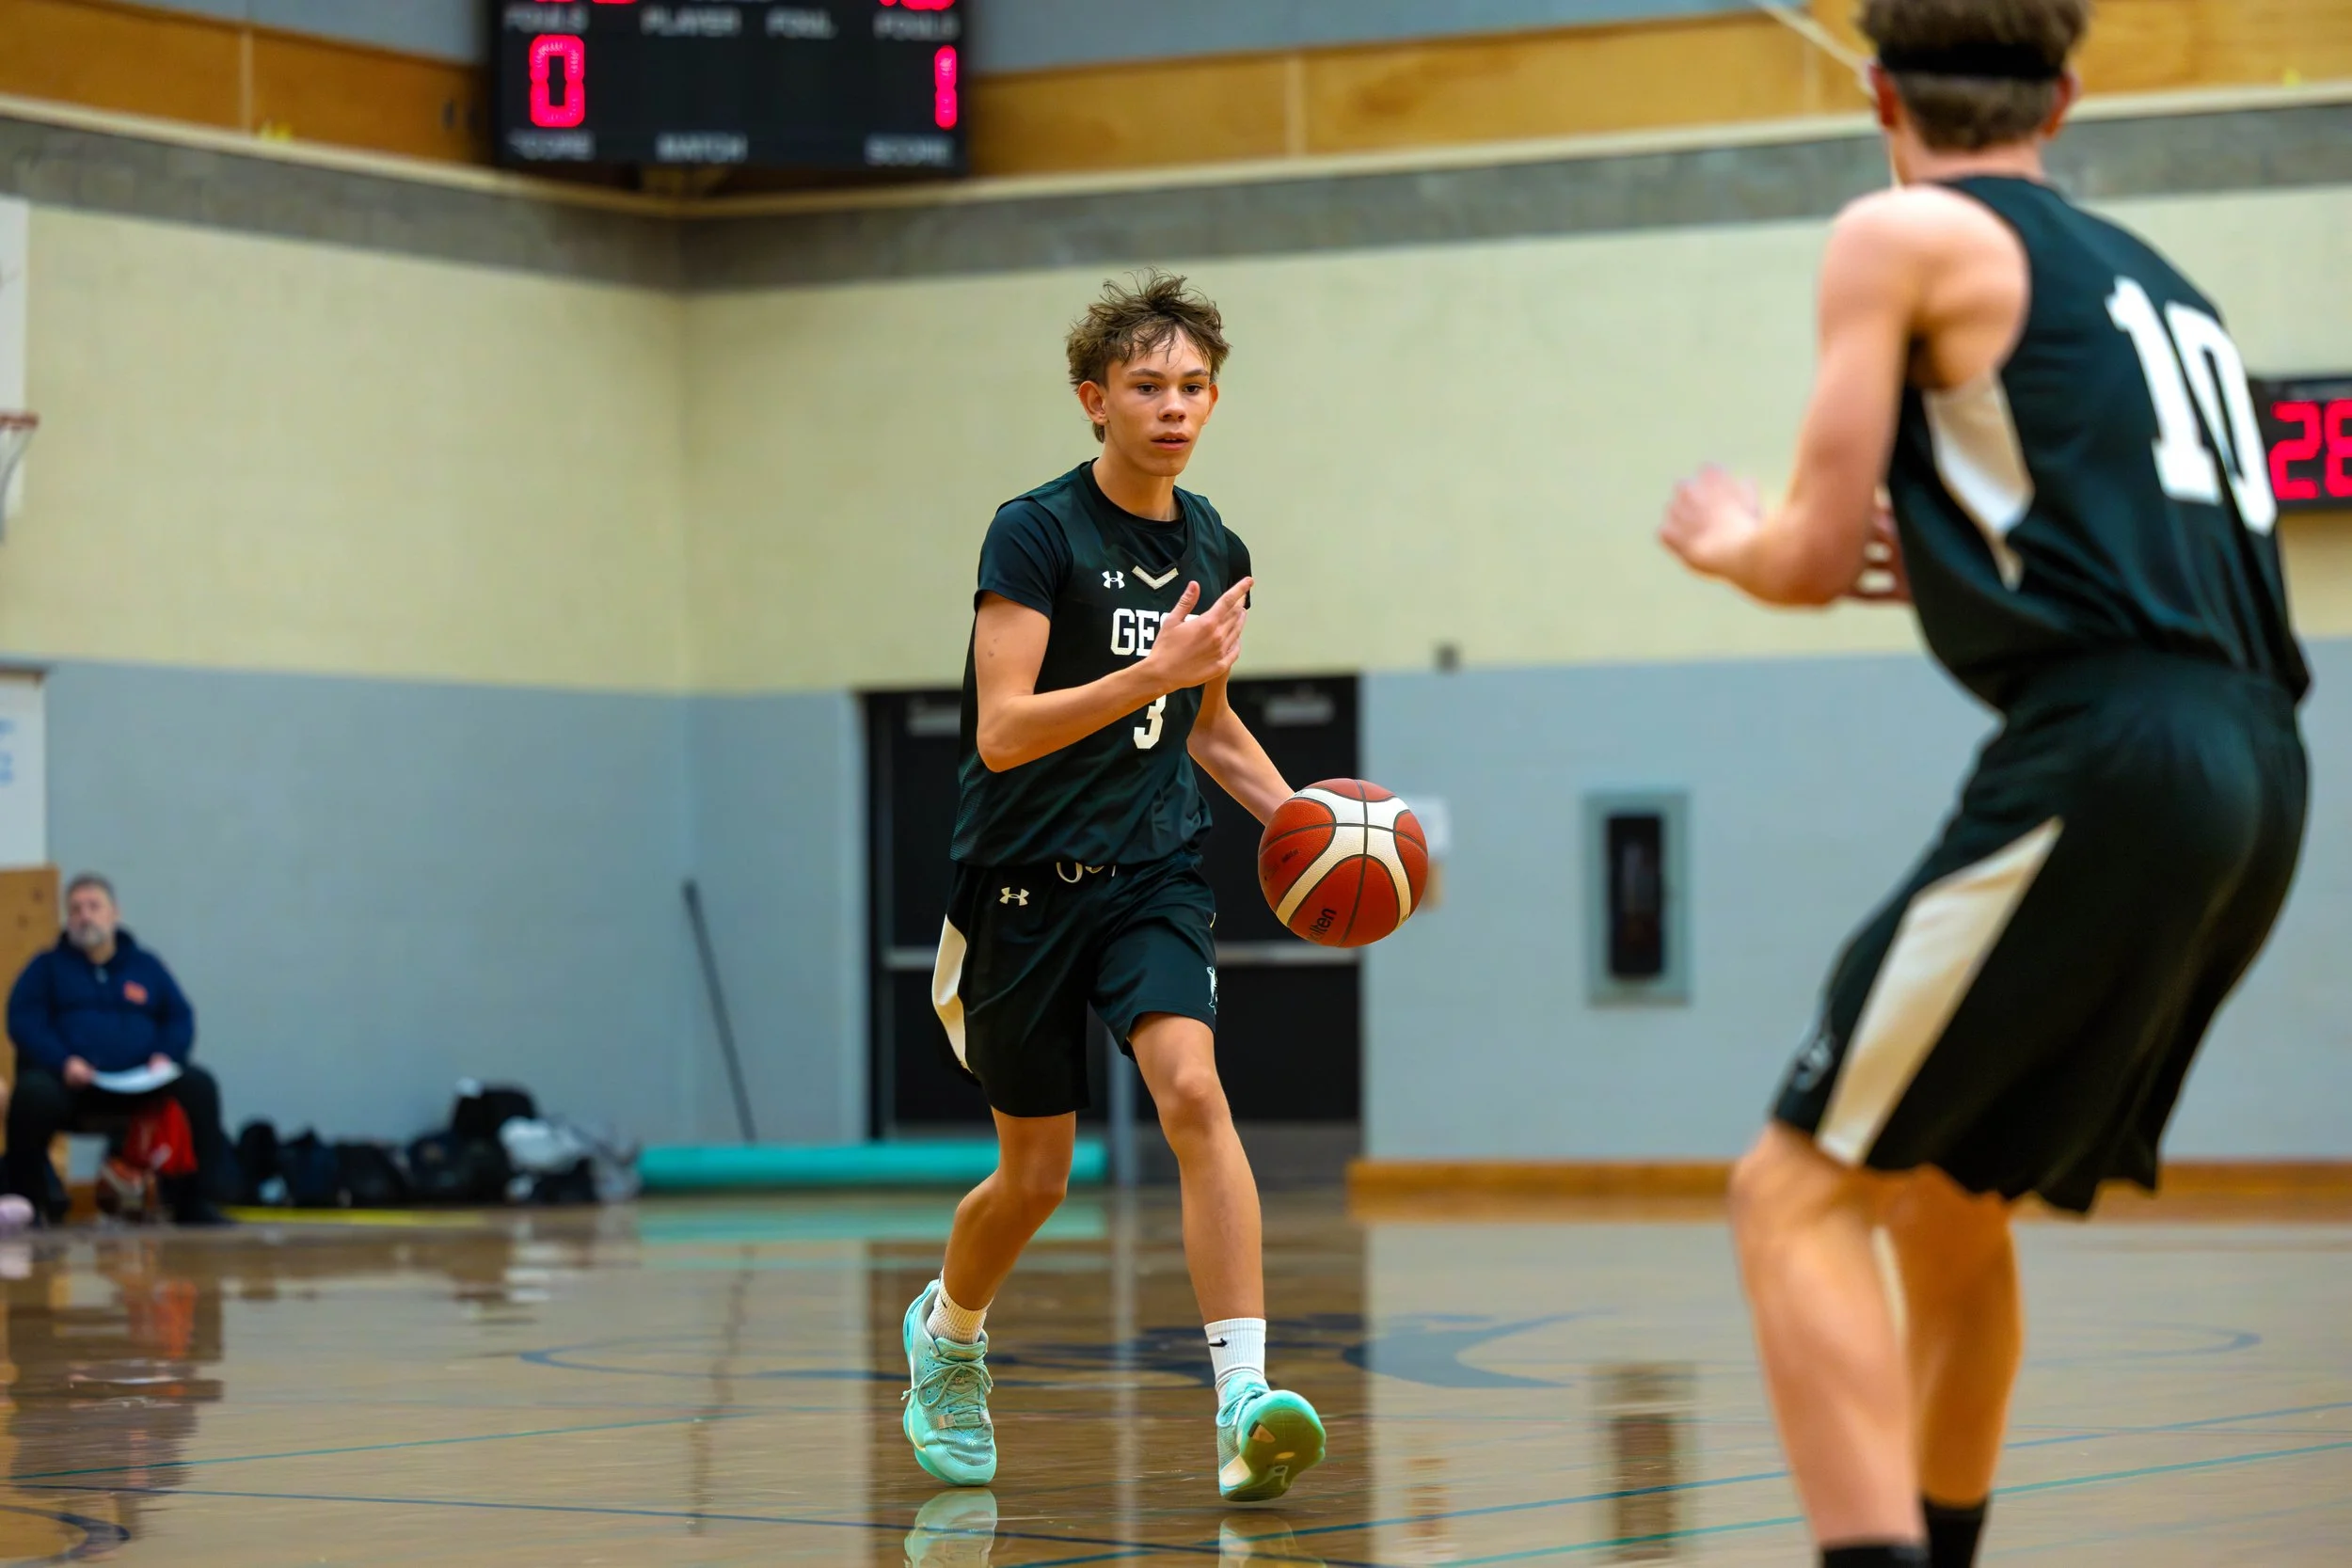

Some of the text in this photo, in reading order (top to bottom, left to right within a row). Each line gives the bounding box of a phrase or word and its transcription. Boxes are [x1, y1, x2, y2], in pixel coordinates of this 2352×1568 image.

[641, 7, 836, 38] PLAYER FOUL
[530, 34, 585, 128] 0
[934, 45, 958, 129] 1
[2105, 275, 2277, 536] 10
[1110, 608, 1200, 657] GE
[1133, 694, 1167, 750] 3
